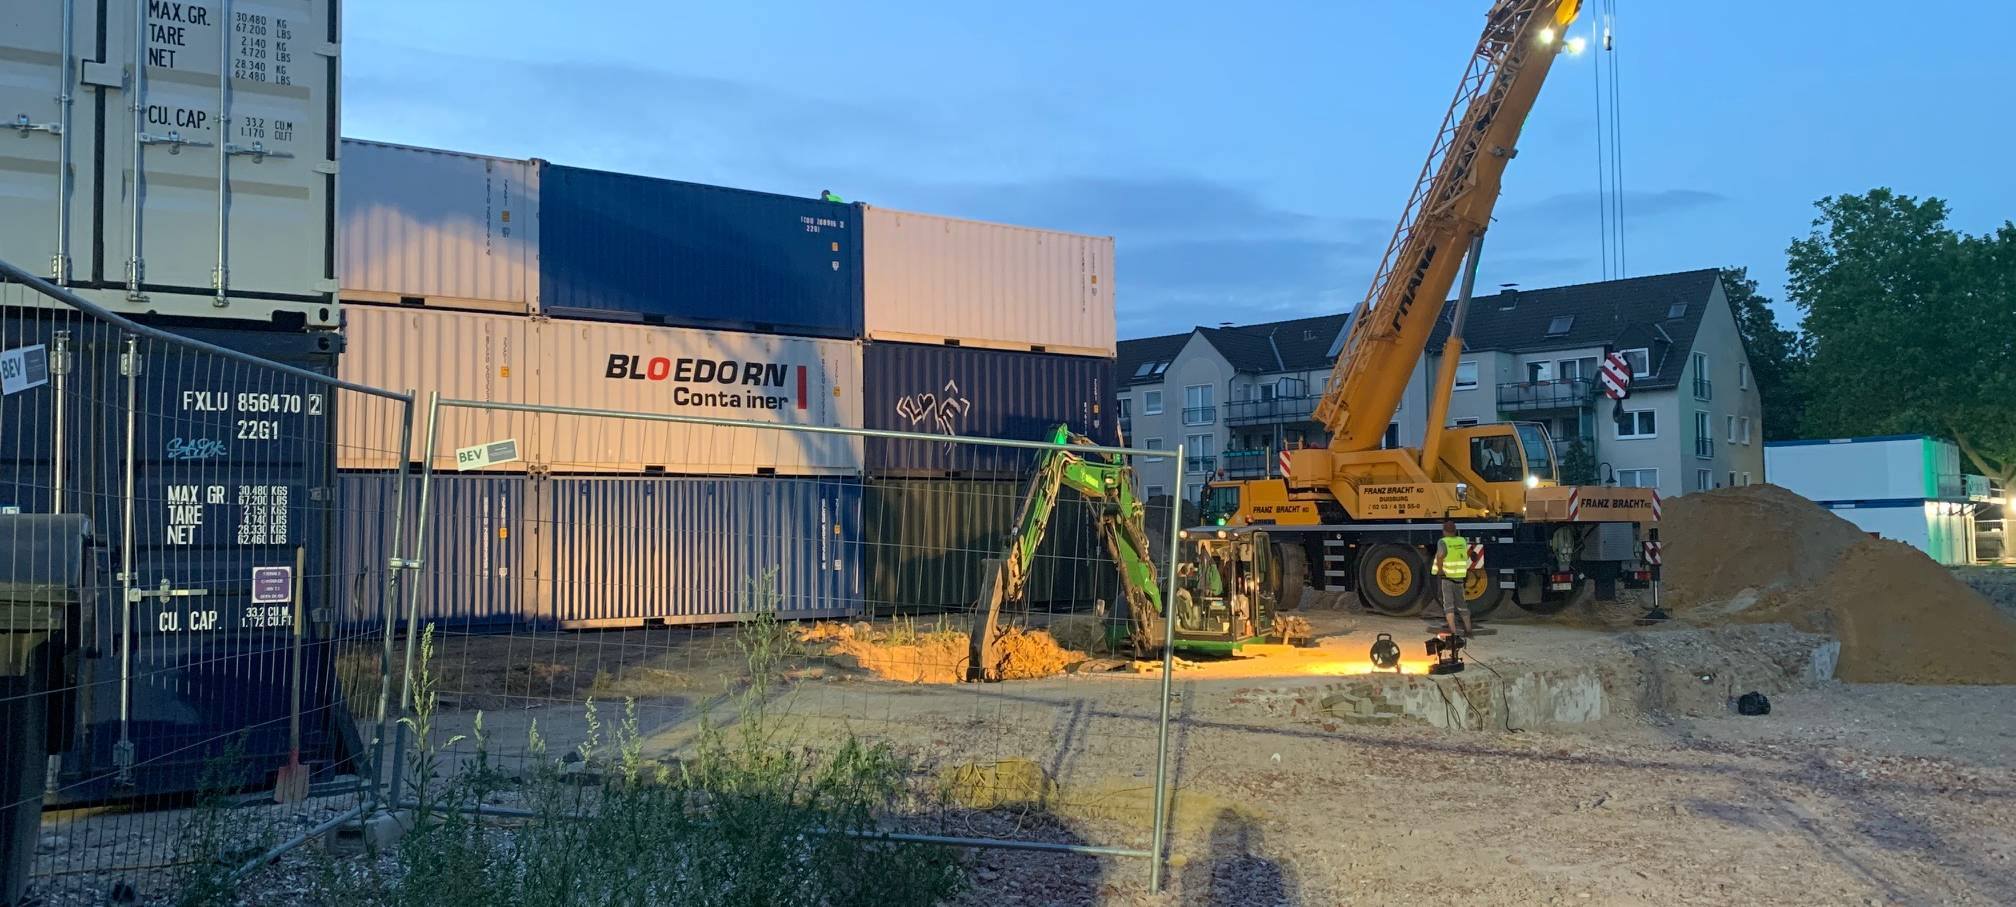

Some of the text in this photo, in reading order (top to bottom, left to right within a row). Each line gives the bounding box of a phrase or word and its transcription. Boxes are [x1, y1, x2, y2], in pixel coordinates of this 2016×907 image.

[235, 12, 287, 29] 30.480 KG
[148, 23, 186, 46] TARE
[235, 23, 292, 40] 67.200 LBS
[241, 36, 287, 52] 2.140 KG
[148, 47, 176, 69] NET
[241, 47, 291, 63] 4.720 LBS
[235, 59, 286, 75] 28.340 KG
[275, 75, 291, 86] LBS
[148, 105, 210, 130] CU. CAP.
[245, 117, 265, 128] 33.2
[241, 126, 265, 139] 1.170
[1, 357, 21, 379] BEV
[605, 353, 788, 388] BLOEDORN
[183, 391, 322, 415] FXLU 856470 2
[673, 386, 789, 410] Container
[237, 420, 278, 440] 22G1
[459, 449, 482, 463] BEV
[238, 486, 288, 496] 30.480 KGS
[1387, 486, 1414, 495] BRACHT
[271, 496, 287, 506] LBS
[1580, 499, 1610, 508] FRANZ
[1612, 499, 1645, 508] BRACHT
[168, 505, 203, 525] TARE
[271, 506, 287, 515] KGS
[1253, 506, 1273, 514] FRANZ
[1276, 505, 1300, 513] BRACHT
[271, 515, 287, 525] LBS
[167, 525, 196, 545] NET
[270, 525, 287, 535] KGS
[270, 535, 287, 545] LBS
[160, 611, 223, 632] CU. CAP.
